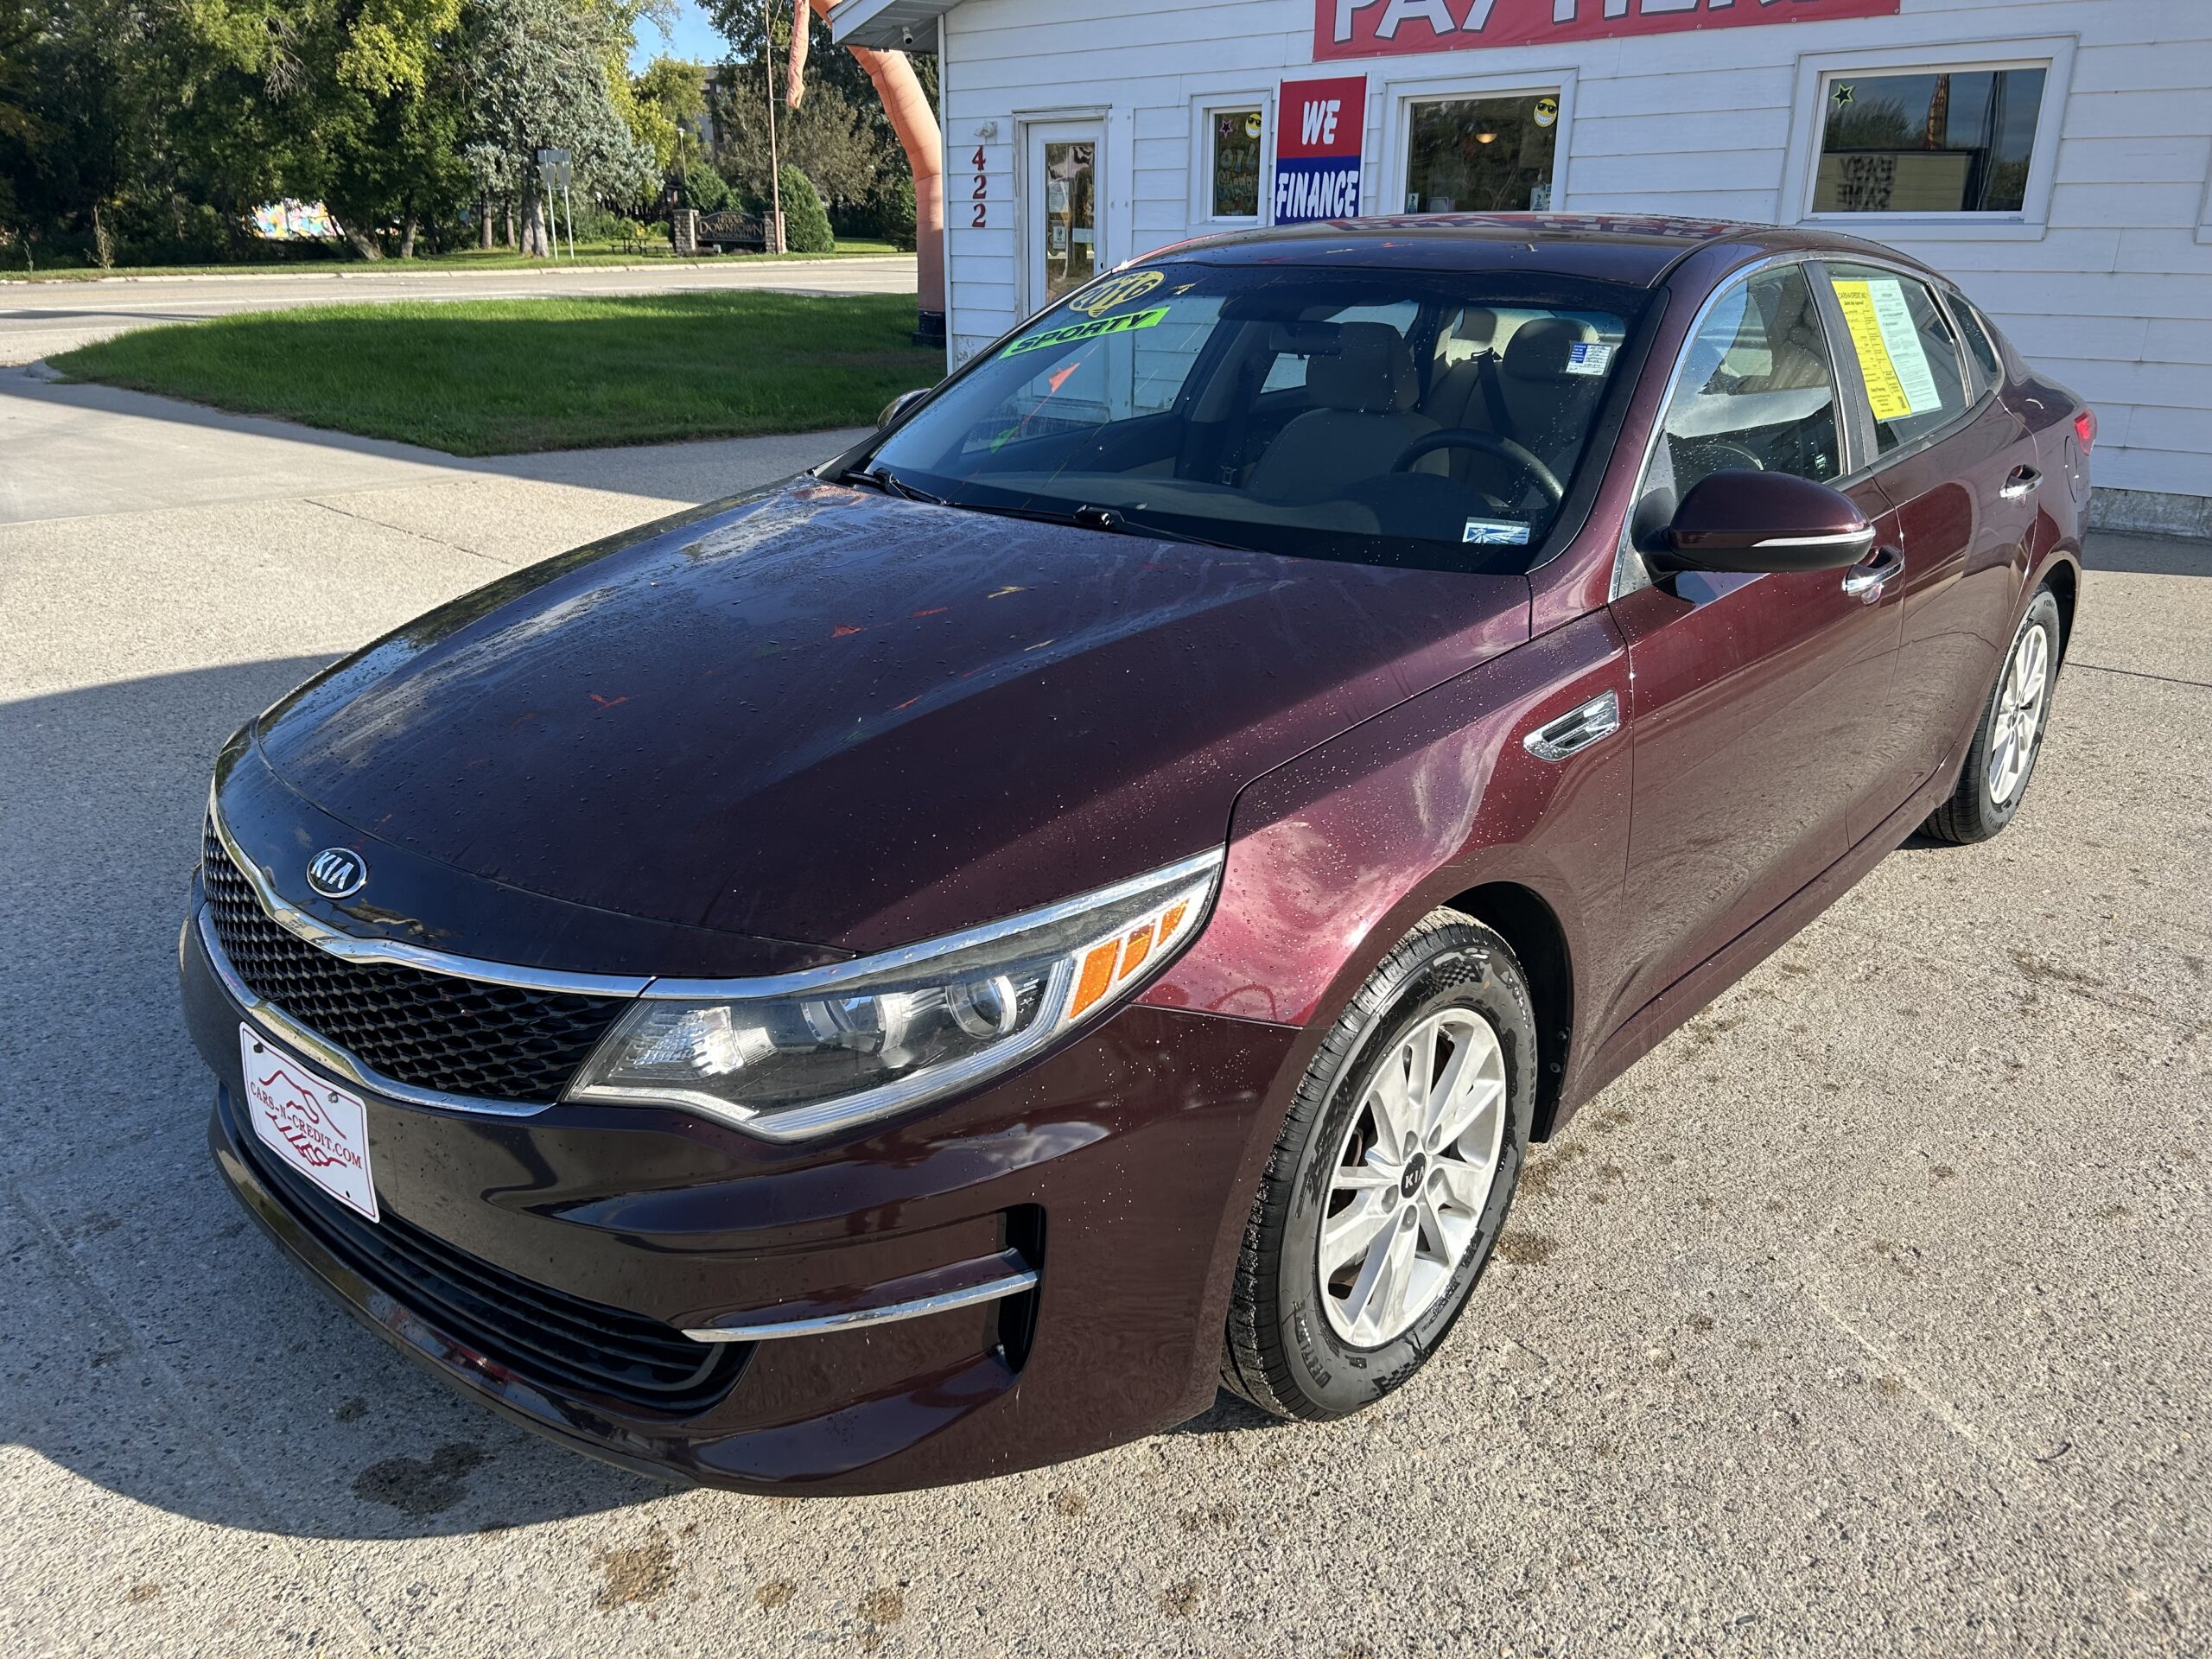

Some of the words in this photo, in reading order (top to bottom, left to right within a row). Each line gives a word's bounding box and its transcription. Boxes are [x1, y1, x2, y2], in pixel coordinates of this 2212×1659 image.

[1333, 0, 1496, 44] PA
[1302, 100, 1340, 145] WE
[971, 145, 987, 227] 422
[1276, 170, 1359, 218] FINANCE
[700, 221, 764, 236] DOWNTOWN
[1073, 279, 1159, 309] 2016
[1011, 312, 1159, 353] SPORTY
[311, 851, 354, 890] KIA
[250, 1081, 363, 1170] CARS-N-CREDIT.COM
[1404, 1166, 1426, 1189] KIA
